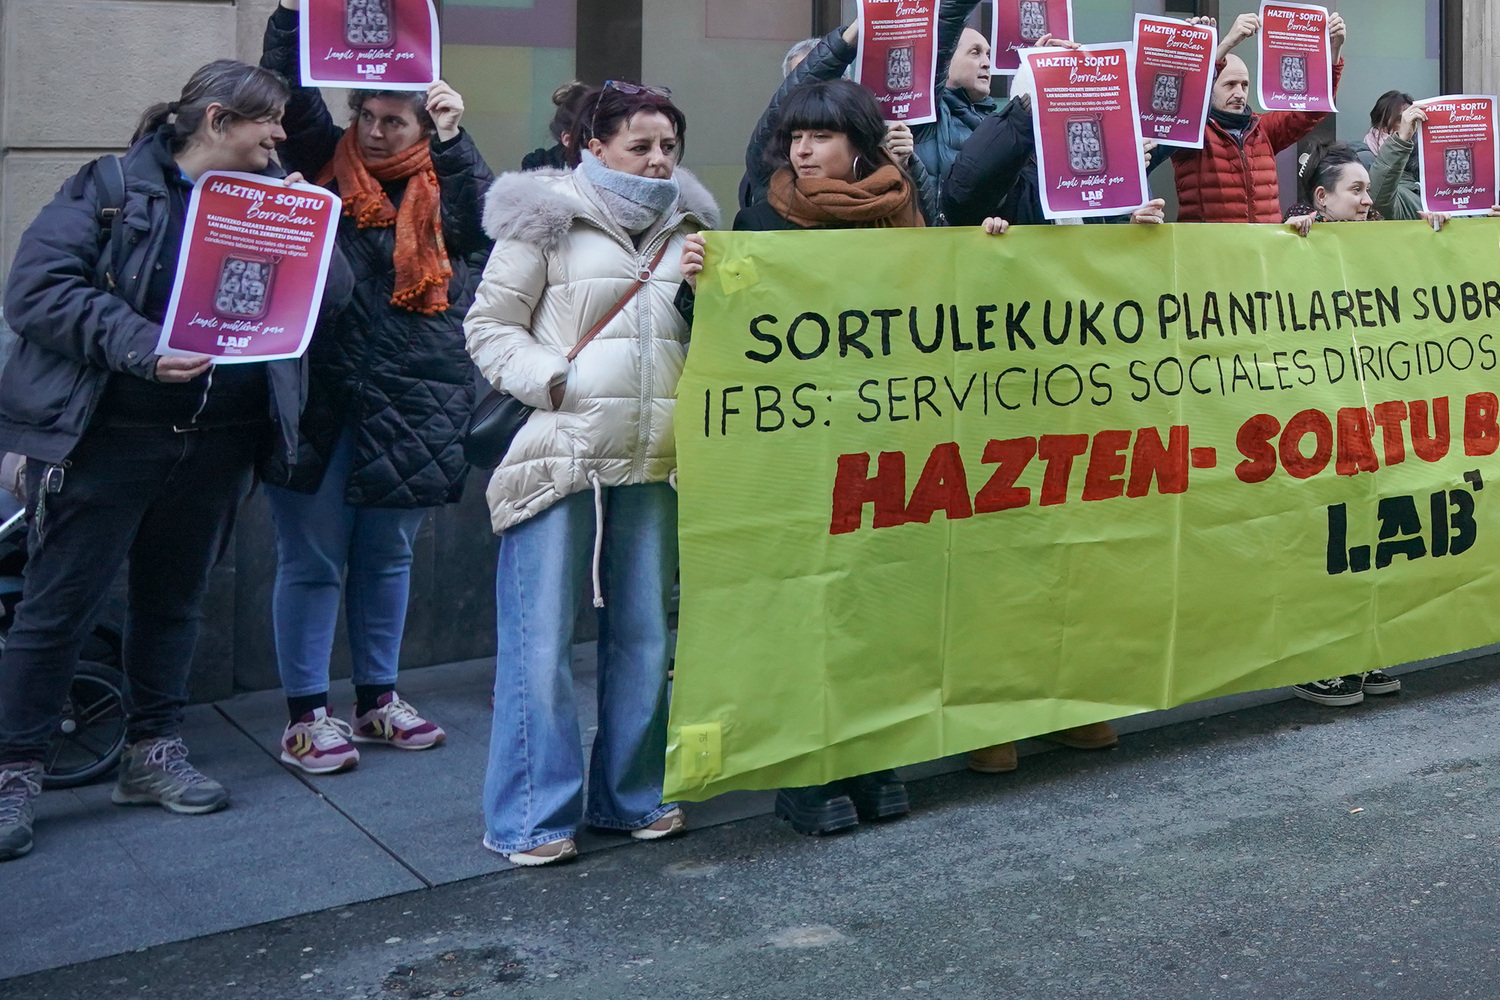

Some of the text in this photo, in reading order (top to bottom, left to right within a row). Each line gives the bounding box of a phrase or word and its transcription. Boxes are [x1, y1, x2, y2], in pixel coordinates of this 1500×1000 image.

[896, 1, 929, 17] Borrokan
[1267, 10, 1322, 21] HAZTEN SORTU
[1144, 24, 1208, 40] HAZTEN SORTU
[1287, 19, 1320, 31] Borrokan
[1166, 35, 1205, 50] Borrokan
[357, 63, 387, 74] LAB
[1036, 57, 1077, 68] HAZTEN
[1085, 56, 1119, 66] SORTU
[1069, 66, 1118, 84] Borrokan
[892, 103, 910, 114] LAB
[1450, 110, 1486, 122] Borrokan
[1154, 125, 1172, 133] LAB
[210, 181, 266, 201] HAZTEN
[275, 194, 324, 211] SORTU
[1081, 189, 1103, 201] LAB
[1453, 196, 1470, 204] LAB
[246, 201, 317, 226] Borrokan
[207, 214, 241, 226] KALITATEZKO
[242, 220, 265, 229] GIZARTE
[265, 225, 299, 235] ZERBITZUEN
[219, 224, 248, 233] BALDINTZA
[259, 230, 286, 239] ZERBITZU
[204, 236, 235, 247] condiciones
[235, 242, 258, 250] laborales
[264, 247, 288, 255] servicios
[232, 235, 254, 243] servicios
[744, 299, 1144, 364] SORTULEKUKO
[1158, 285, 1401, 340] PLANTILAREN
[216, 335, 252, 347] LAB
[703, 382, 833, 438] IFBS:
[857, 362, 1114, 423] SERVICIOS
[1129, 349, 1316, 402] SOCIALES
[1323, 333, 1497, 384] DIRIGIDOS
[828, 423, 1218, 535] HAZTEN-
[1234, 396, 1450, 484] SORTU
[1326, 488, 1478, 575] LAB
